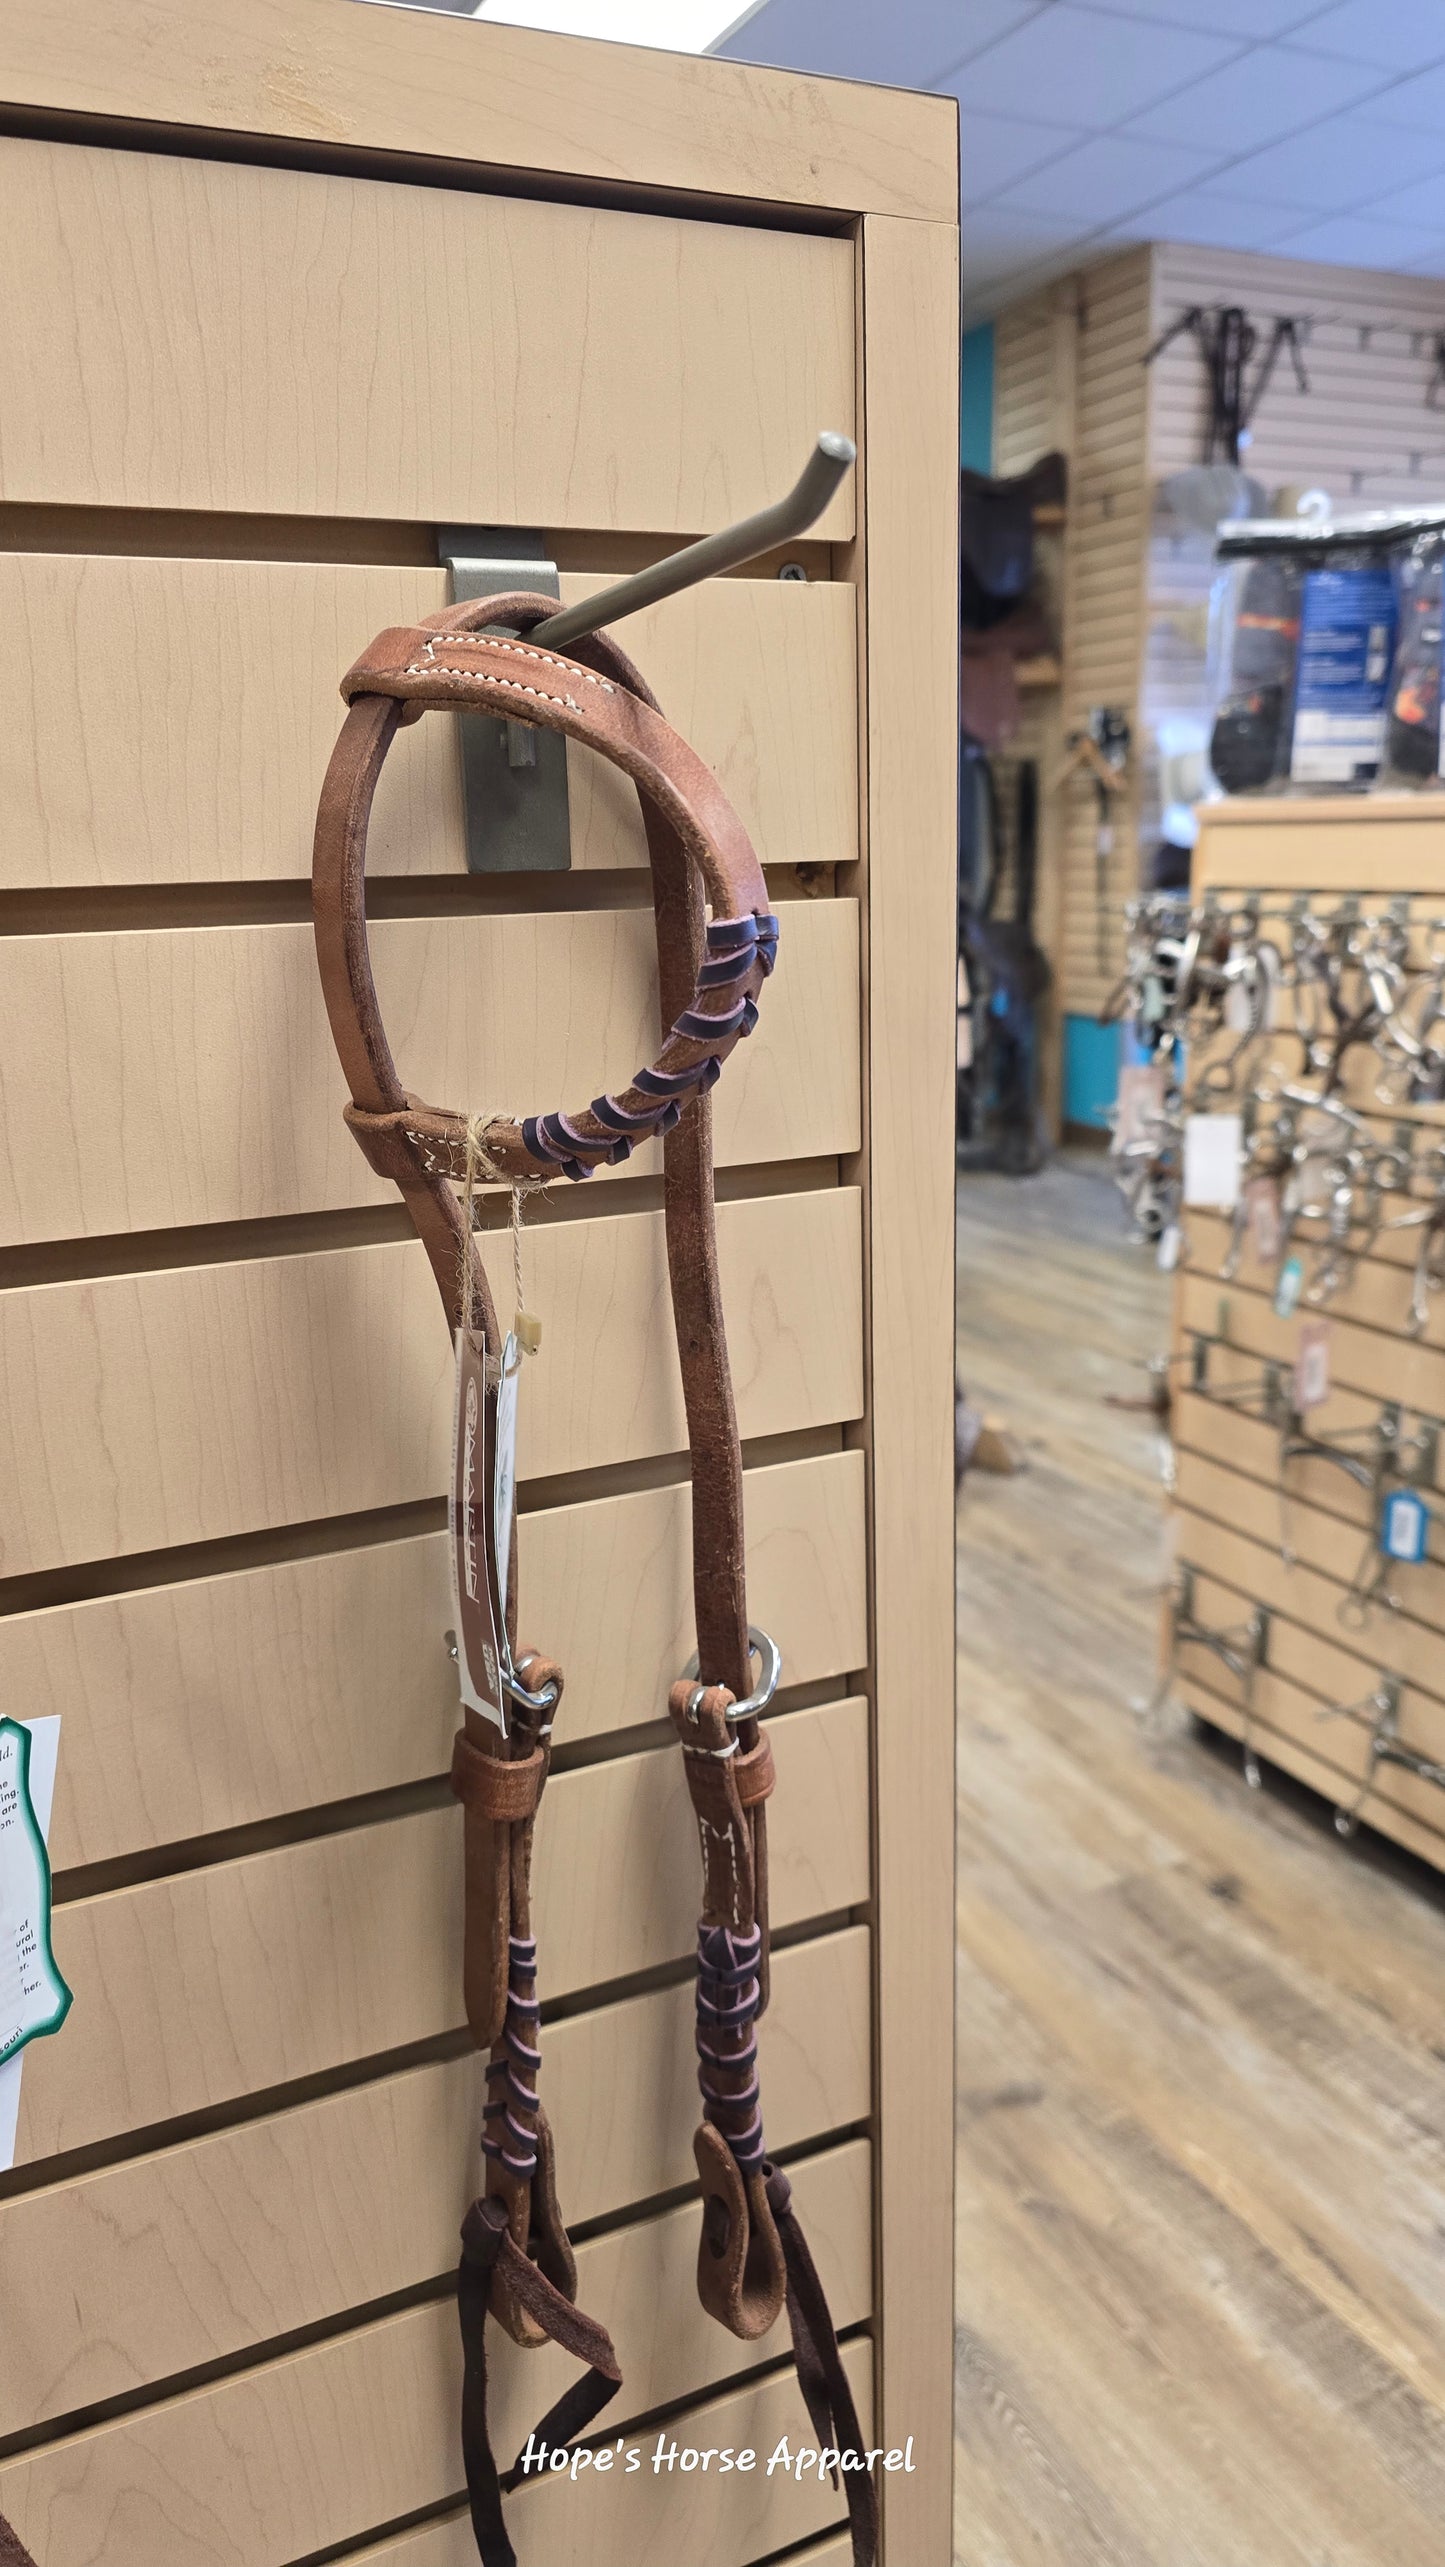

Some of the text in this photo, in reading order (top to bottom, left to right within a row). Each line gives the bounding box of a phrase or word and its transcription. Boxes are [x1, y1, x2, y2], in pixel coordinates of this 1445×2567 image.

[2, 1802, 17, 1815] are
[19, 1918, 29, 1931] of
[22, 1943, 37, 1957] the
